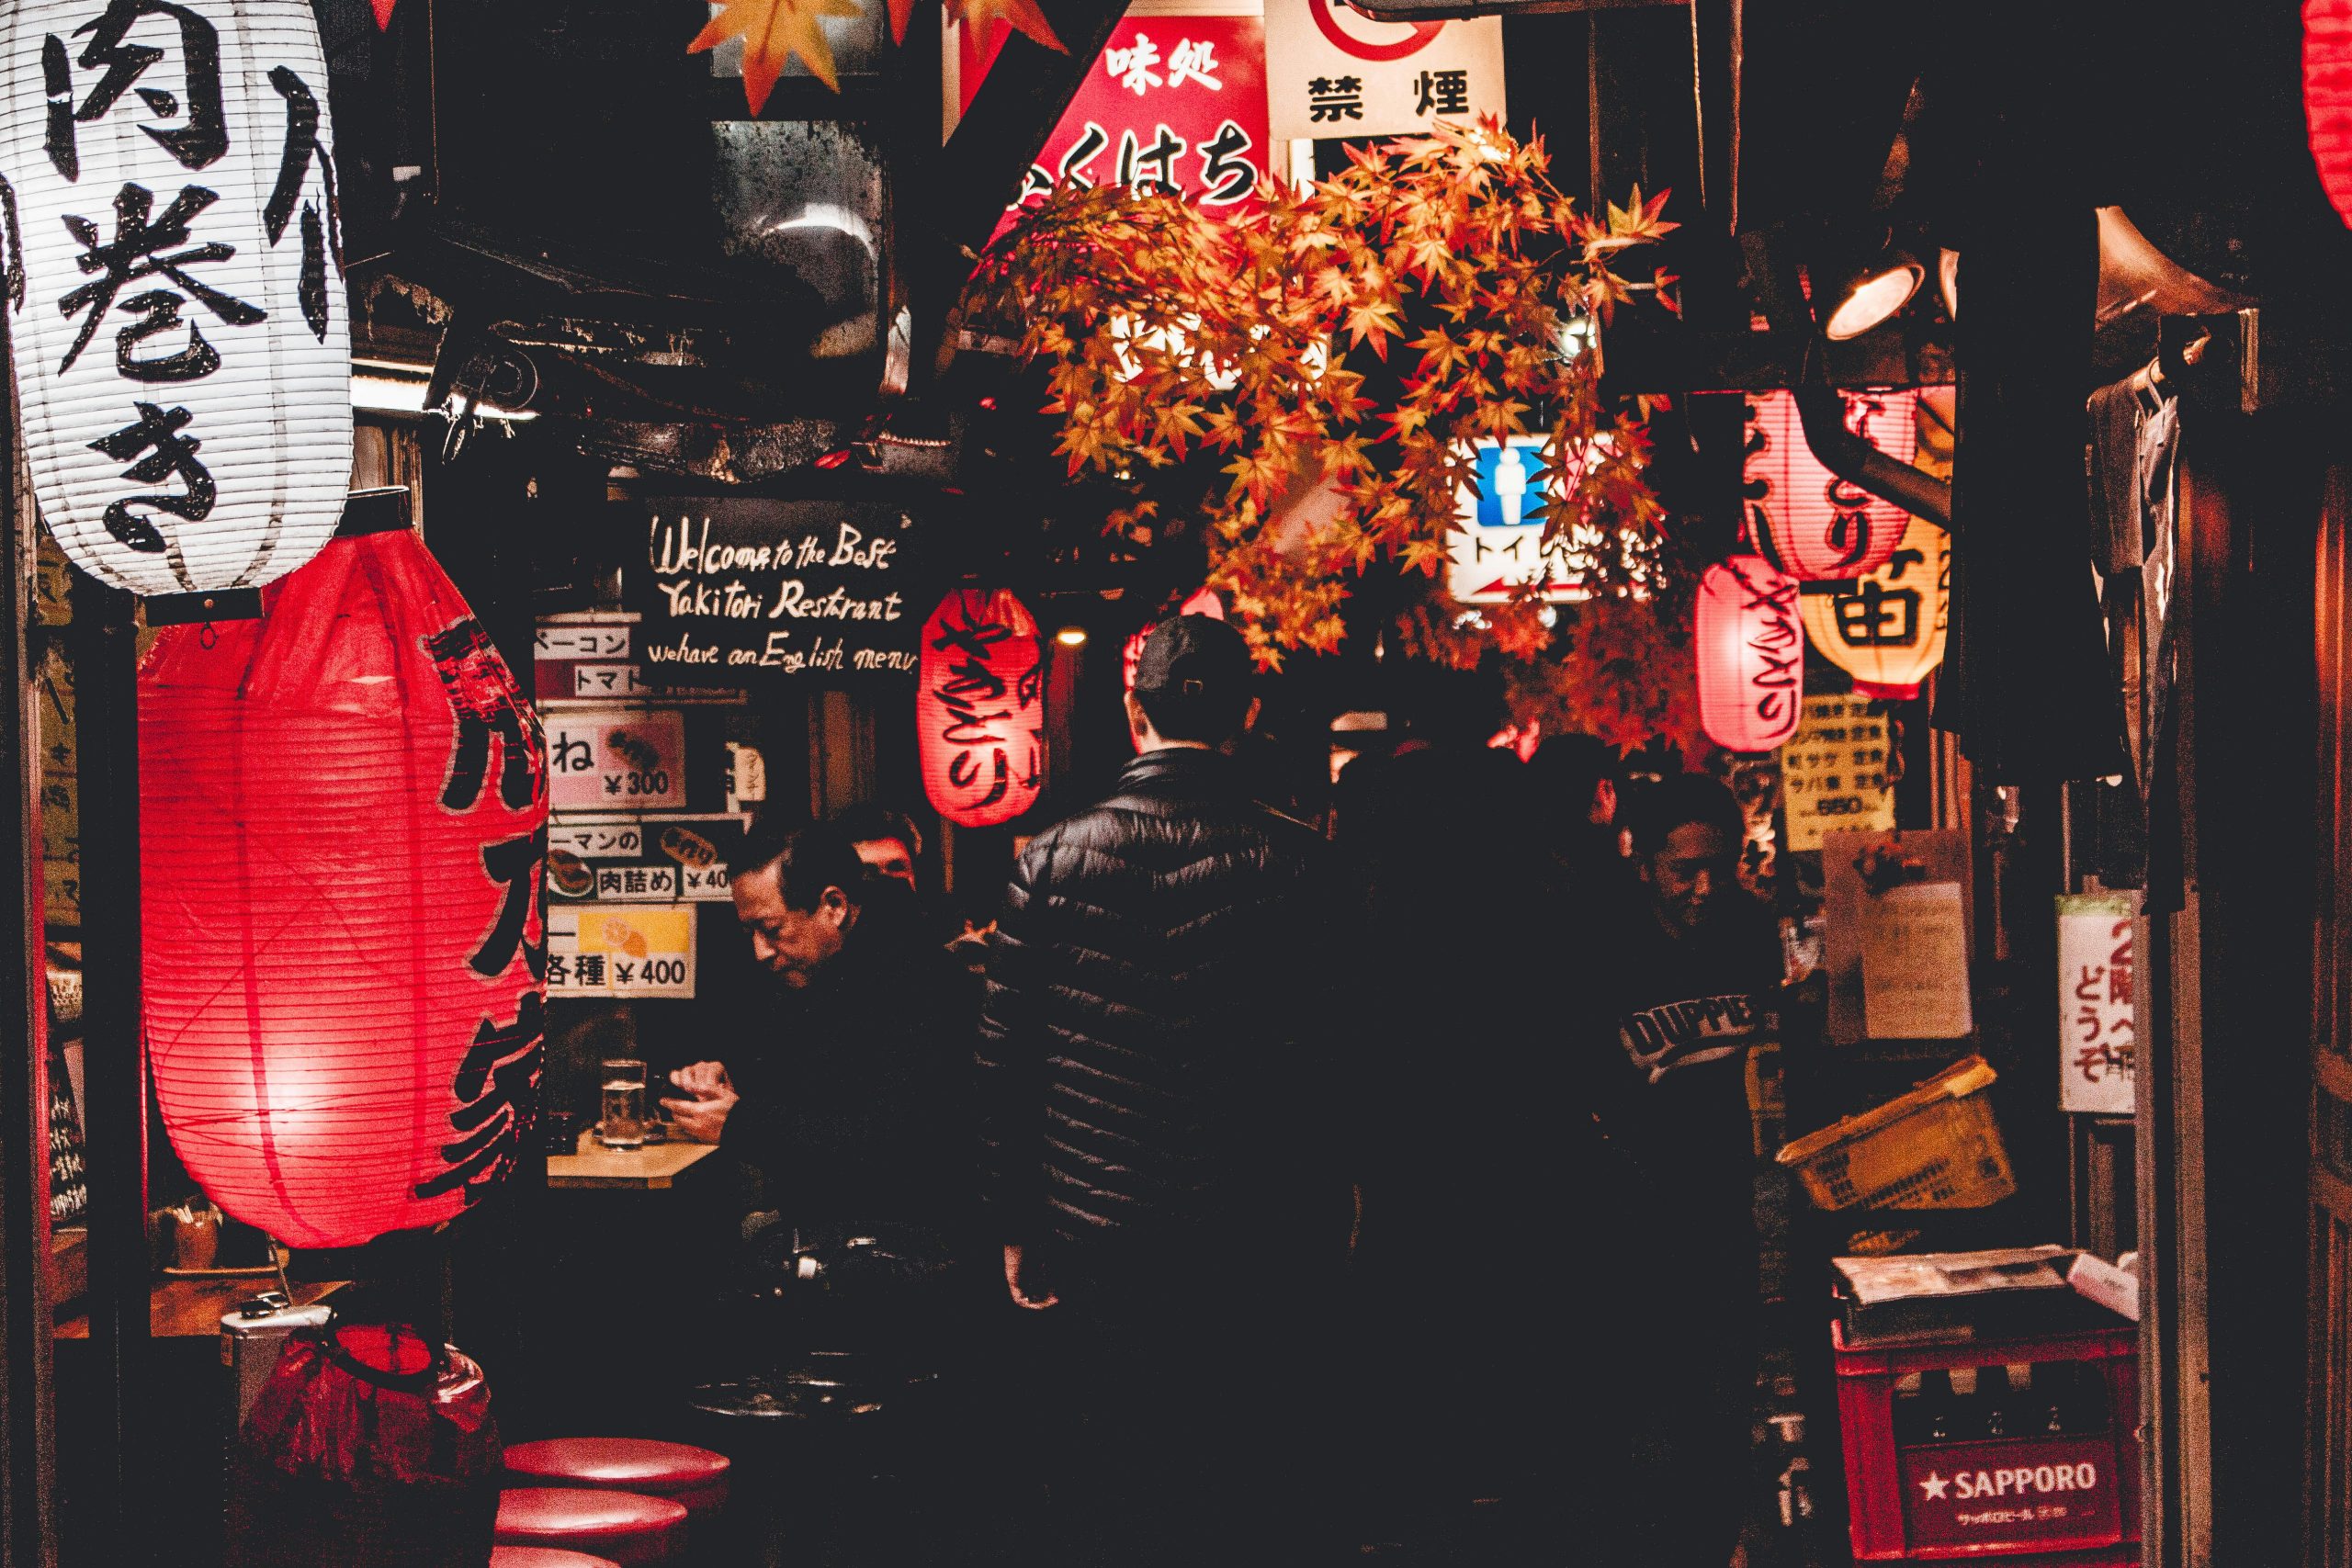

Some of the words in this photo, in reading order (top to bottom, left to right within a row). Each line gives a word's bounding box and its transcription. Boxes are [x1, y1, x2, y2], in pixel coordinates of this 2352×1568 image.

[1104, 32, 1223, 96] 味処
[1307, 70, 1470, 123] 禁煙
[42, 0, 268, 553] 肉巻き
[649, 514, 771, 574] Welcome
[773, 539, 793, 570] to
[795, 535, 826, 570] the
[828, 521, 897, 570] Best
[727, 648, 758, 666] an
[759, 630, 843, 674] English
[552, 731, 594, 773] ね
[600, 871, 673, 894] 肉詰め
[686, 869, 733, 890] ¥40
[548, 954, 606, 987] 各種
[1954, 1461, 2097, 1500] SAPPORO
